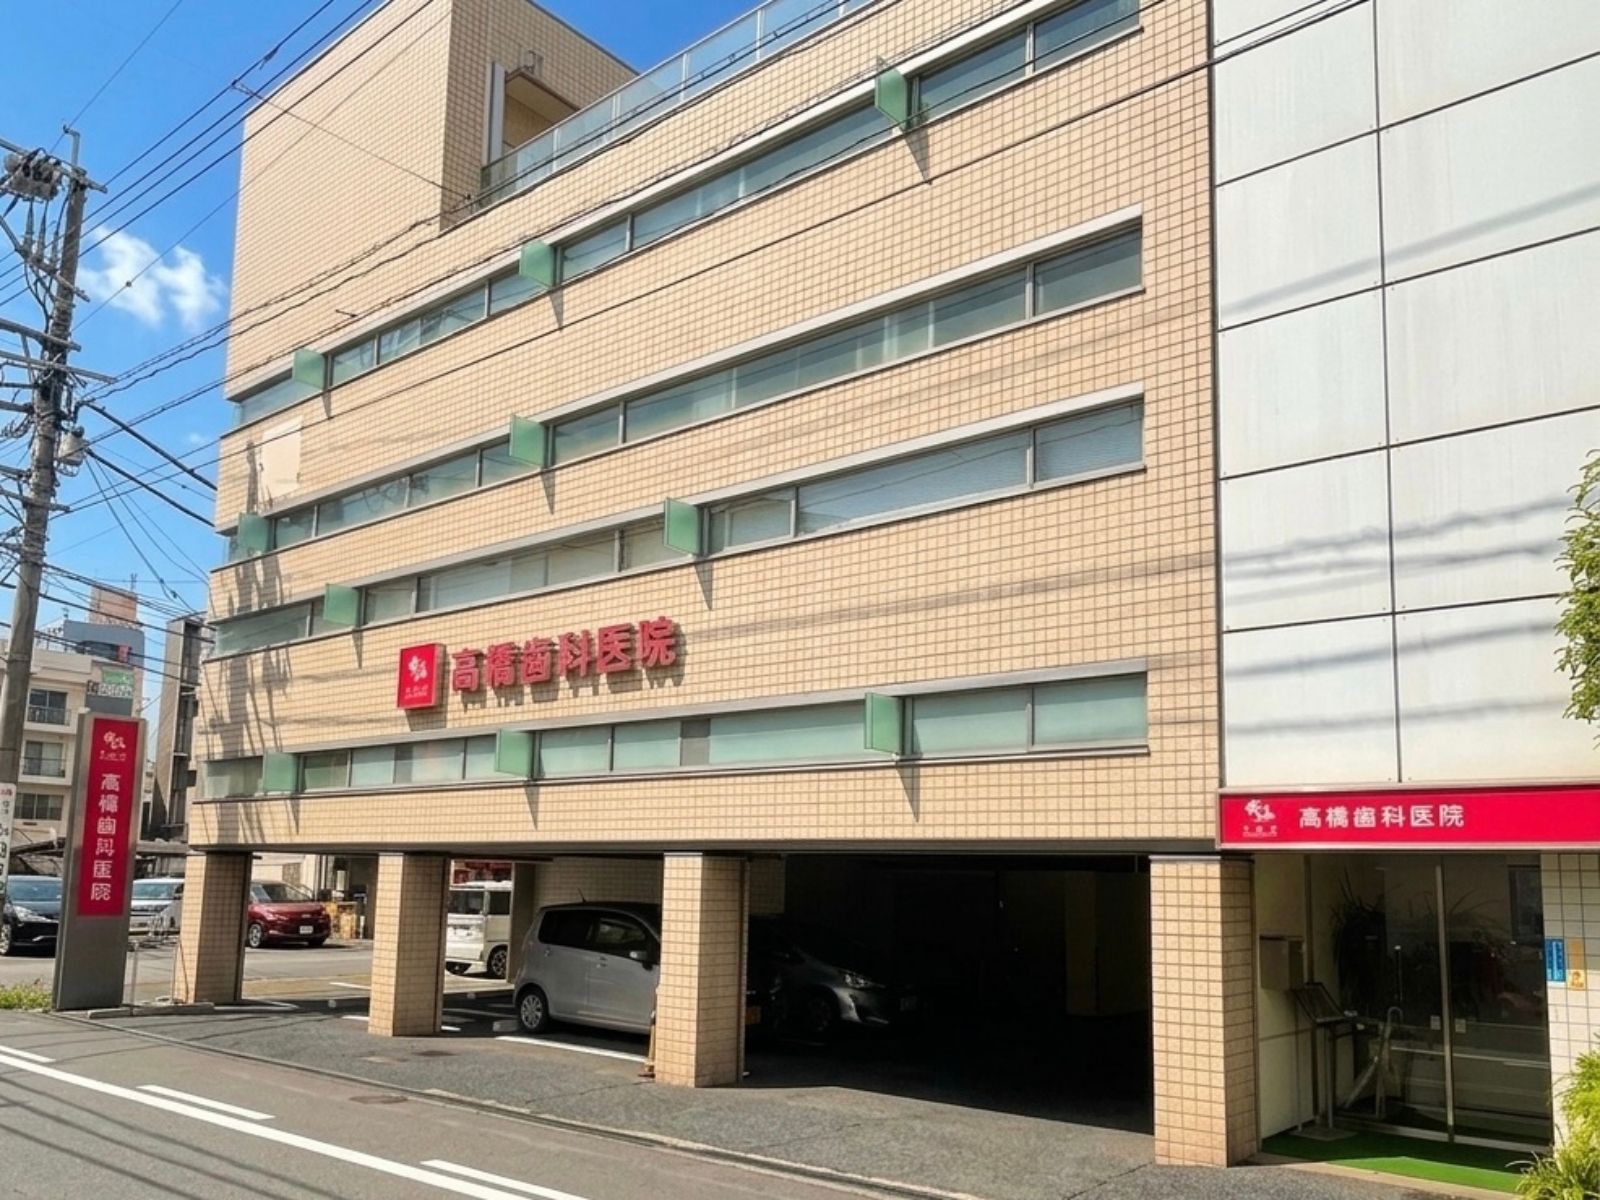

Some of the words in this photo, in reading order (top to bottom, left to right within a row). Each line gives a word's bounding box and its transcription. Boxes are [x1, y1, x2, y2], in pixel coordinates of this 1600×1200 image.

[1299, 804, 1465, 829] 高橋歯科医院
